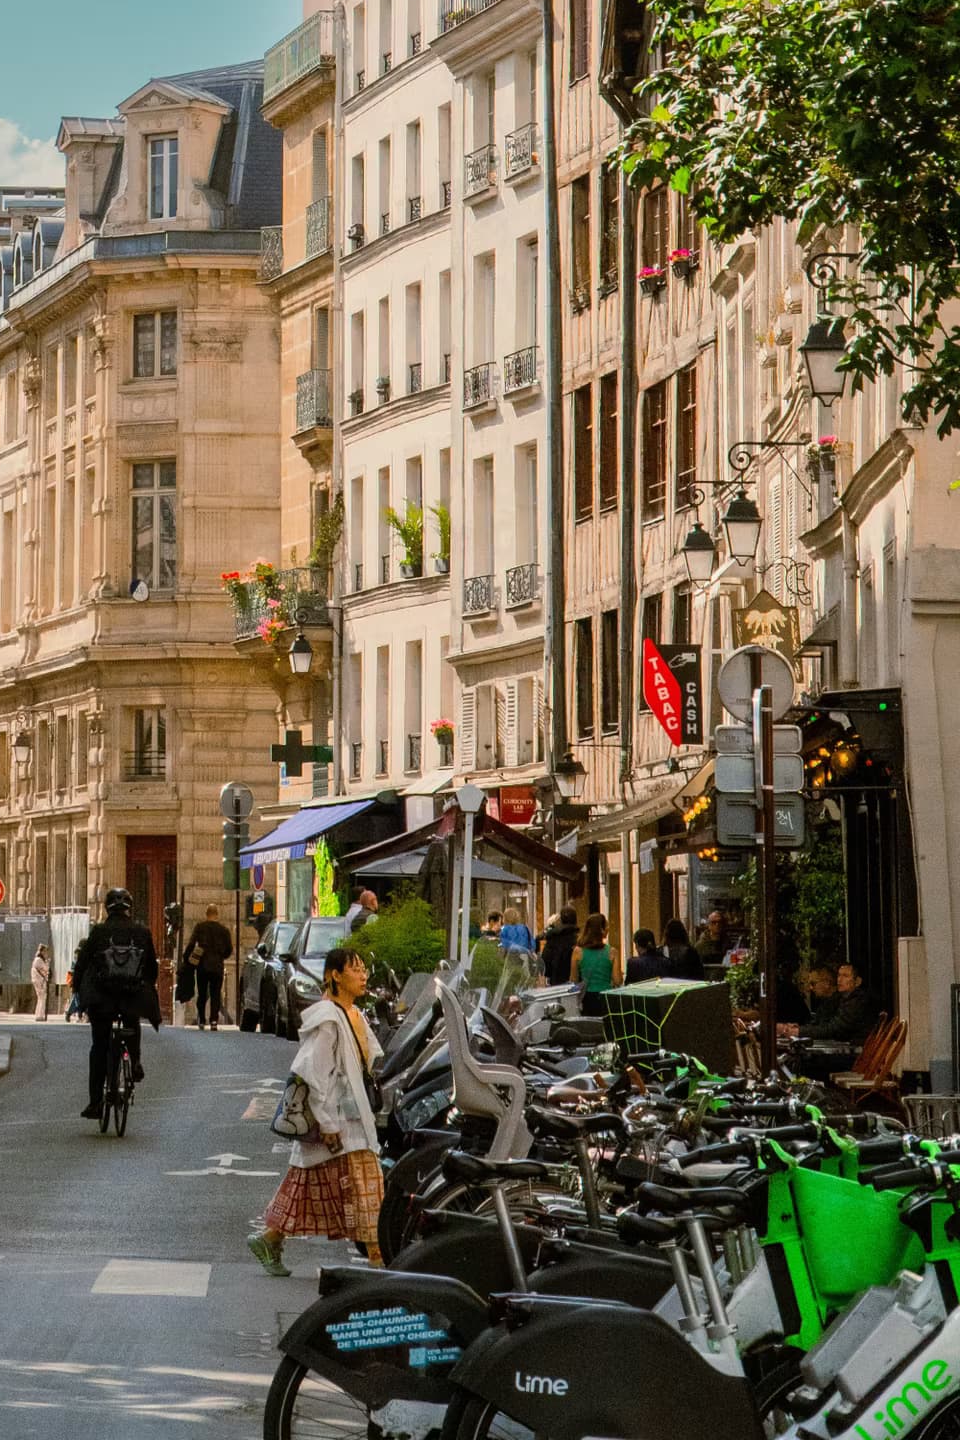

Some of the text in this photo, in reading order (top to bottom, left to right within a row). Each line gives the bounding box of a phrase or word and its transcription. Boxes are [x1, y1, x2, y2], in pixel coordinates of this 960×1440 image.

[648, 656, 680, 730] TABAC
[685, 681, 698, 735] CASH
[325, 1314, 425, 1332] BUTTES-CHAUMONT
[348, 1307, 403, 1320] ALLER AUX
[332, 1323, 425, 1340] SANS UNE GOUTTE
[337, 1340, 352, 1349] DE
[353, 1336, 396, 1348] TRANSPI
[407, 1329, 445, 1341] CHECK.
[515, 1371, 569, 1396] Lime
